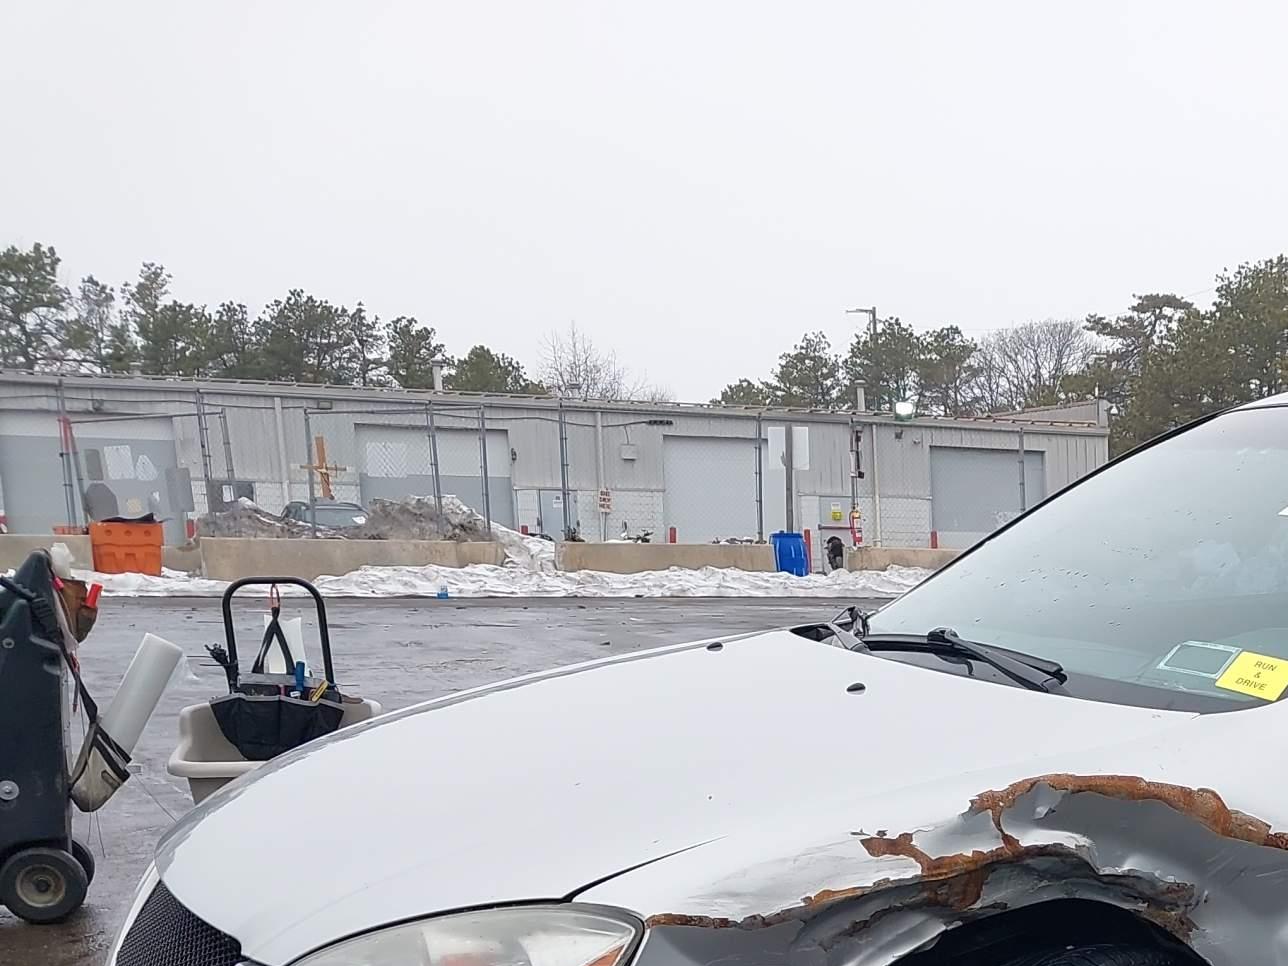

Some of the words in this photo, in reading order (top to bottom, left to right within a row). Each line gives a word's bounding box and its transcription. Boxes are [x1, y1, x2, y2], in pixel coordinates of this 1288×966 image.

[1254, 660, 1278, 672] RUN
[1253, 671, 1262, 679] &
[1235, 677, 1267, 691] DRIVE
